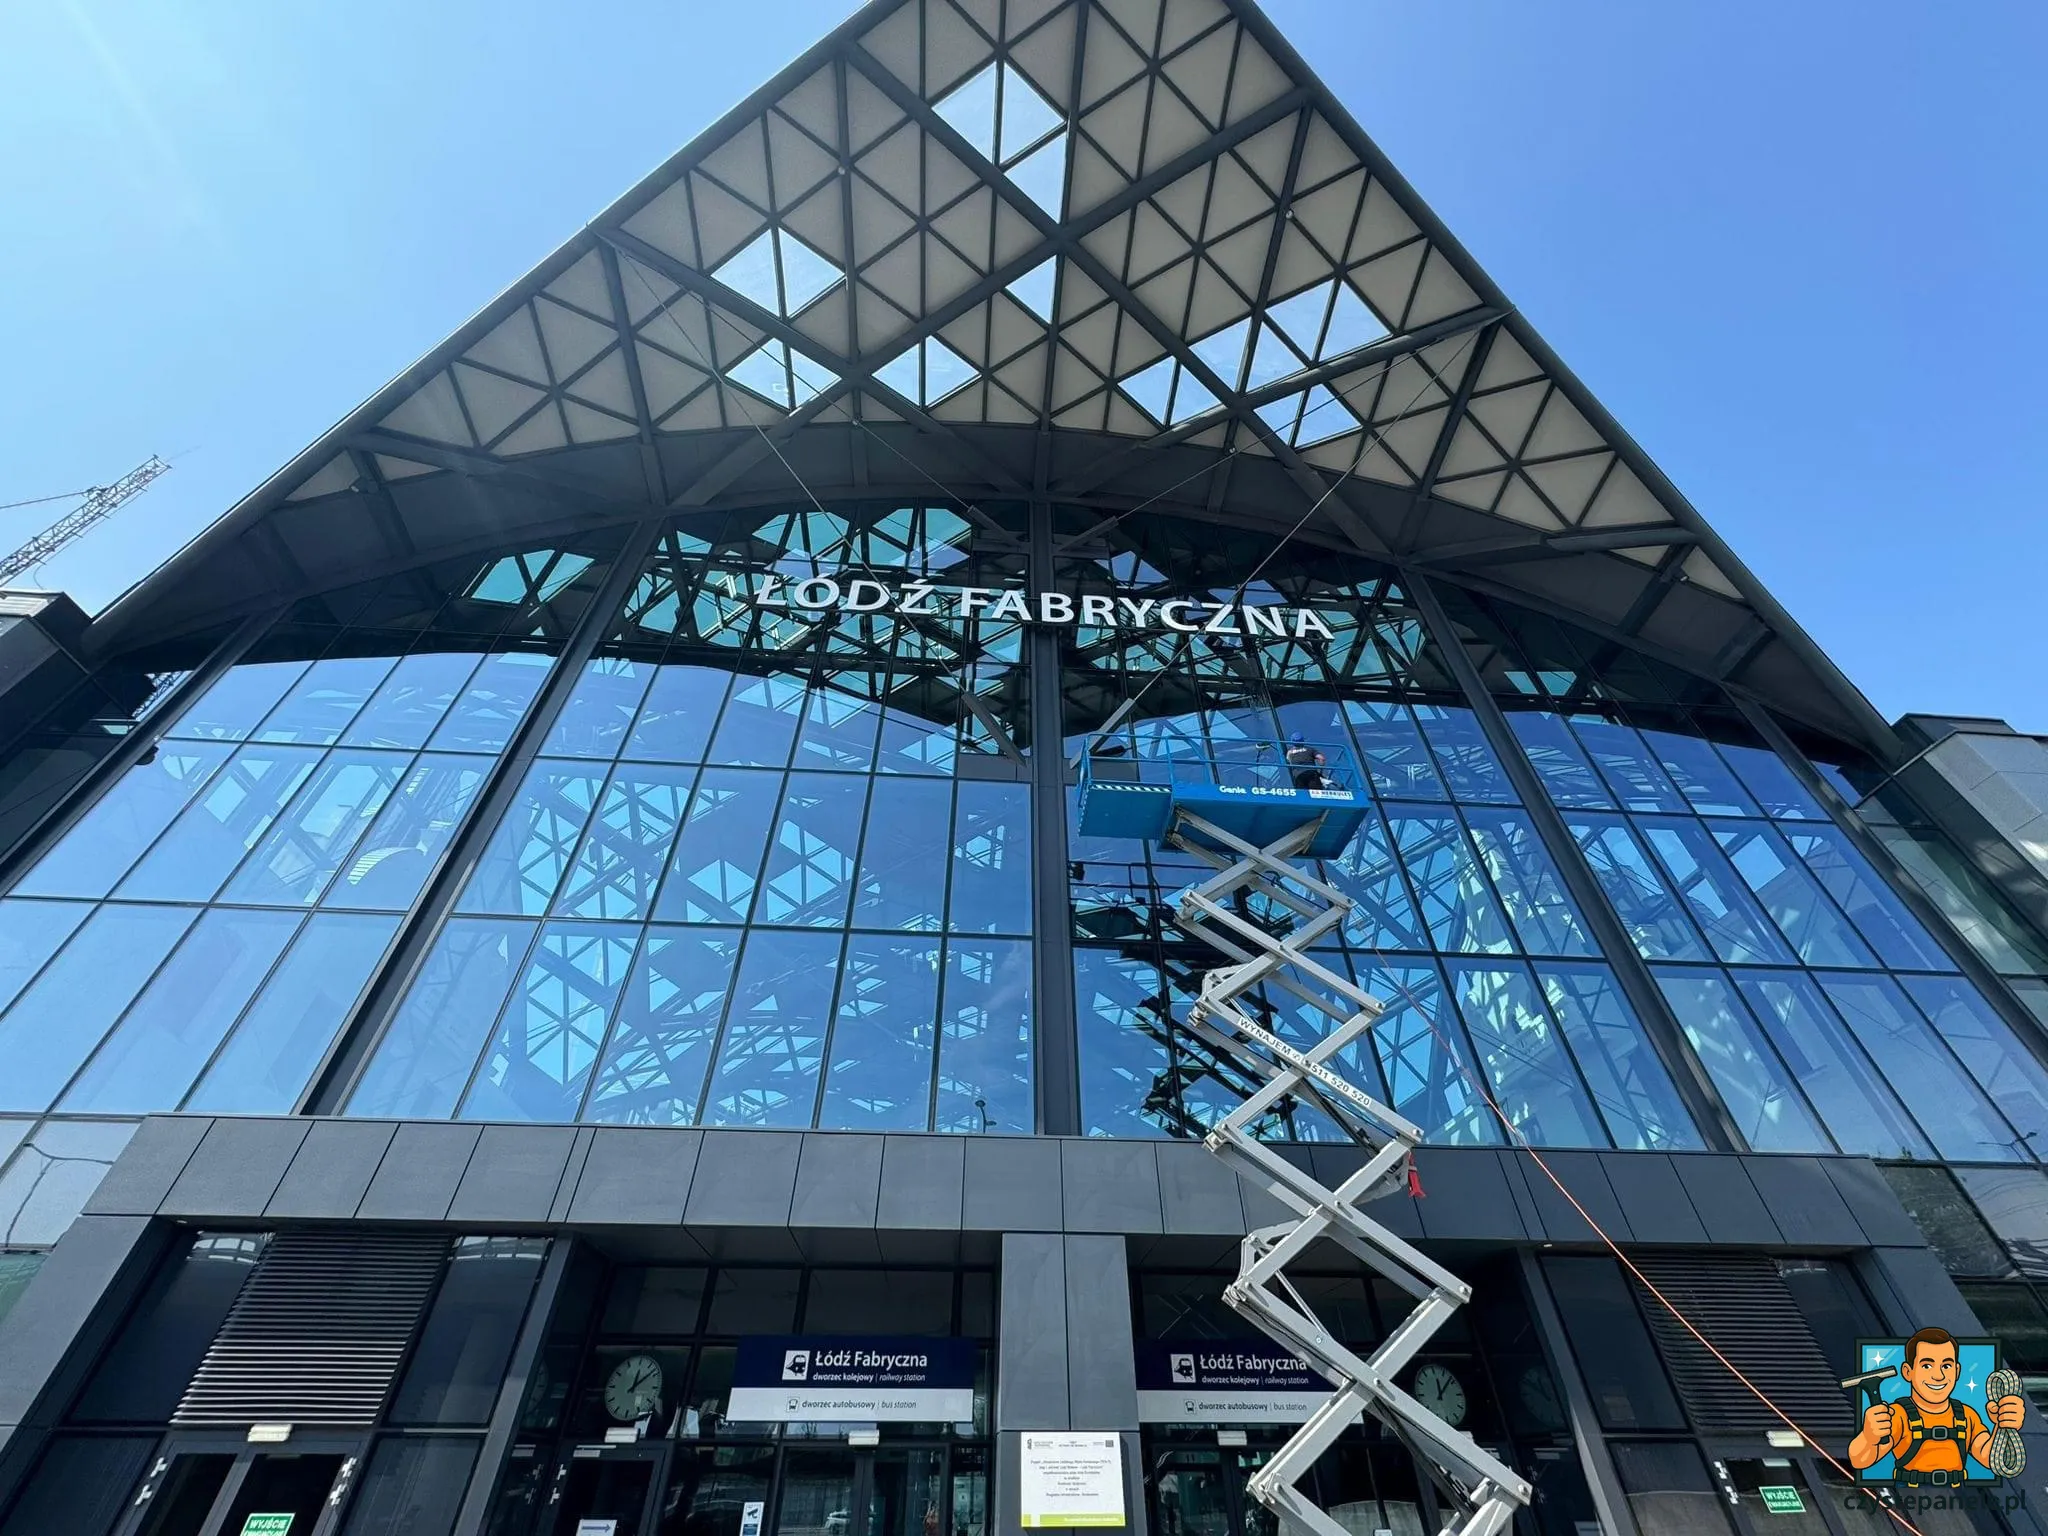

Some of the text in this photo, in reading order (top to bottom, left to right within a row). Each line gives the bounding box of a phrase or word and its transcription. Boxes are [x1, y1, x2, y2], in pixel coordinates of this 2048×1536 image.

[754, 573, 1335, 640] ŁÓDŹ FABRYCZNA
[1219, 785, 1297, 797] Genie GS-4655
[1239, 1018, 1371, 1106] WYNAJEM 511 520 520
[815, 1350, 928, 1371] Łódź Fabryczna
[1200, 1354, 1308, 1374] Łódź Fabryczna
[812, 1372, 926, 1383] dworzec kolejowy railway station
[1202, 1375, 1309, 1386] dworzec kolejowy railway station
[802, 1400, 917, 1411] dworzec autobusowy bus station
[1199, 1402, 1308, 1412] dworzec autobusowy bus station
[249, 1517, 288, 1529] WYJŚCIE
